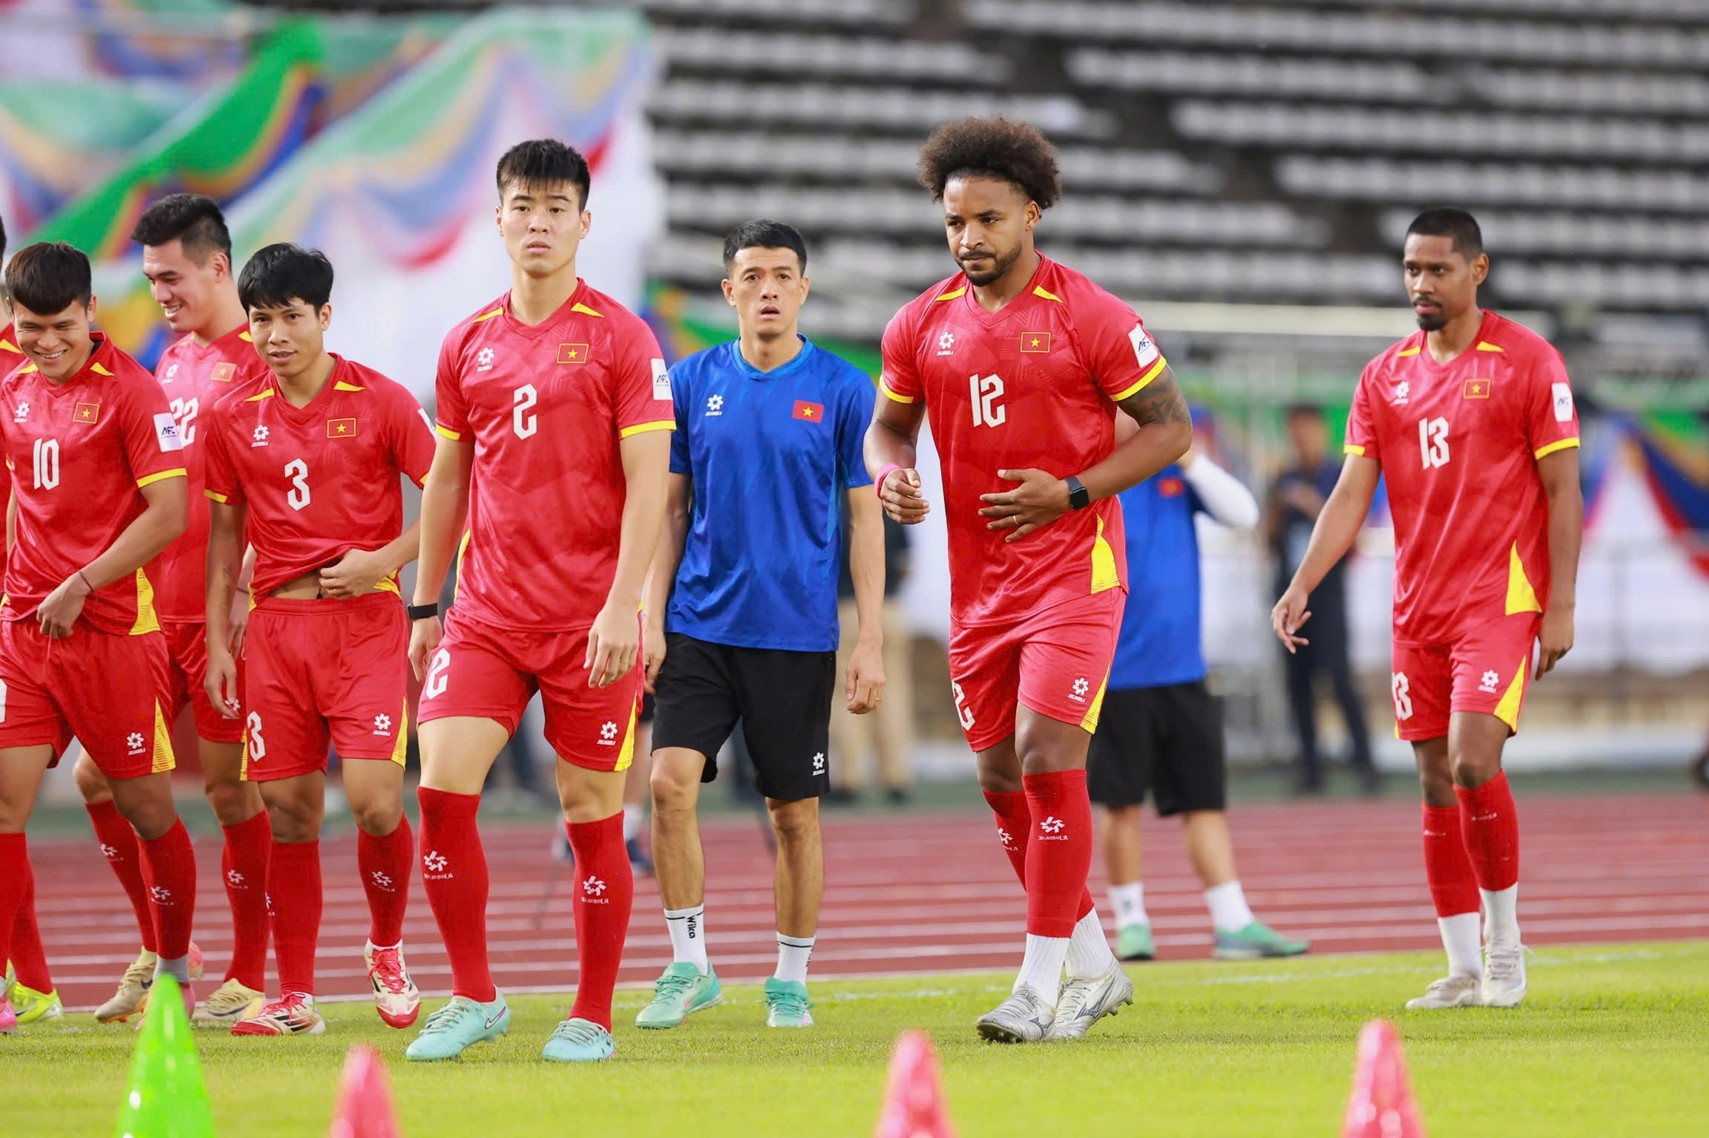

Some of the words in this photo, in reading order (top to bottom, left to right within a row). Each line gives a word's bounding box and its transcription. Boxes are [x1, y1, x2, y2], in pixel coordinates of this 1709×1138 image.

[513, 383, 537, 440] 2
[969, 373, 1006, 428] 12
[33, 437, 60, 491] 10
[1418, 416, 1451, 470] 13
[284, 458, 311, 511] 3
[425, 648, 451, 700] 2
[247, 711, 266, 762] 3
[687, 915, 697, 939] Wika
